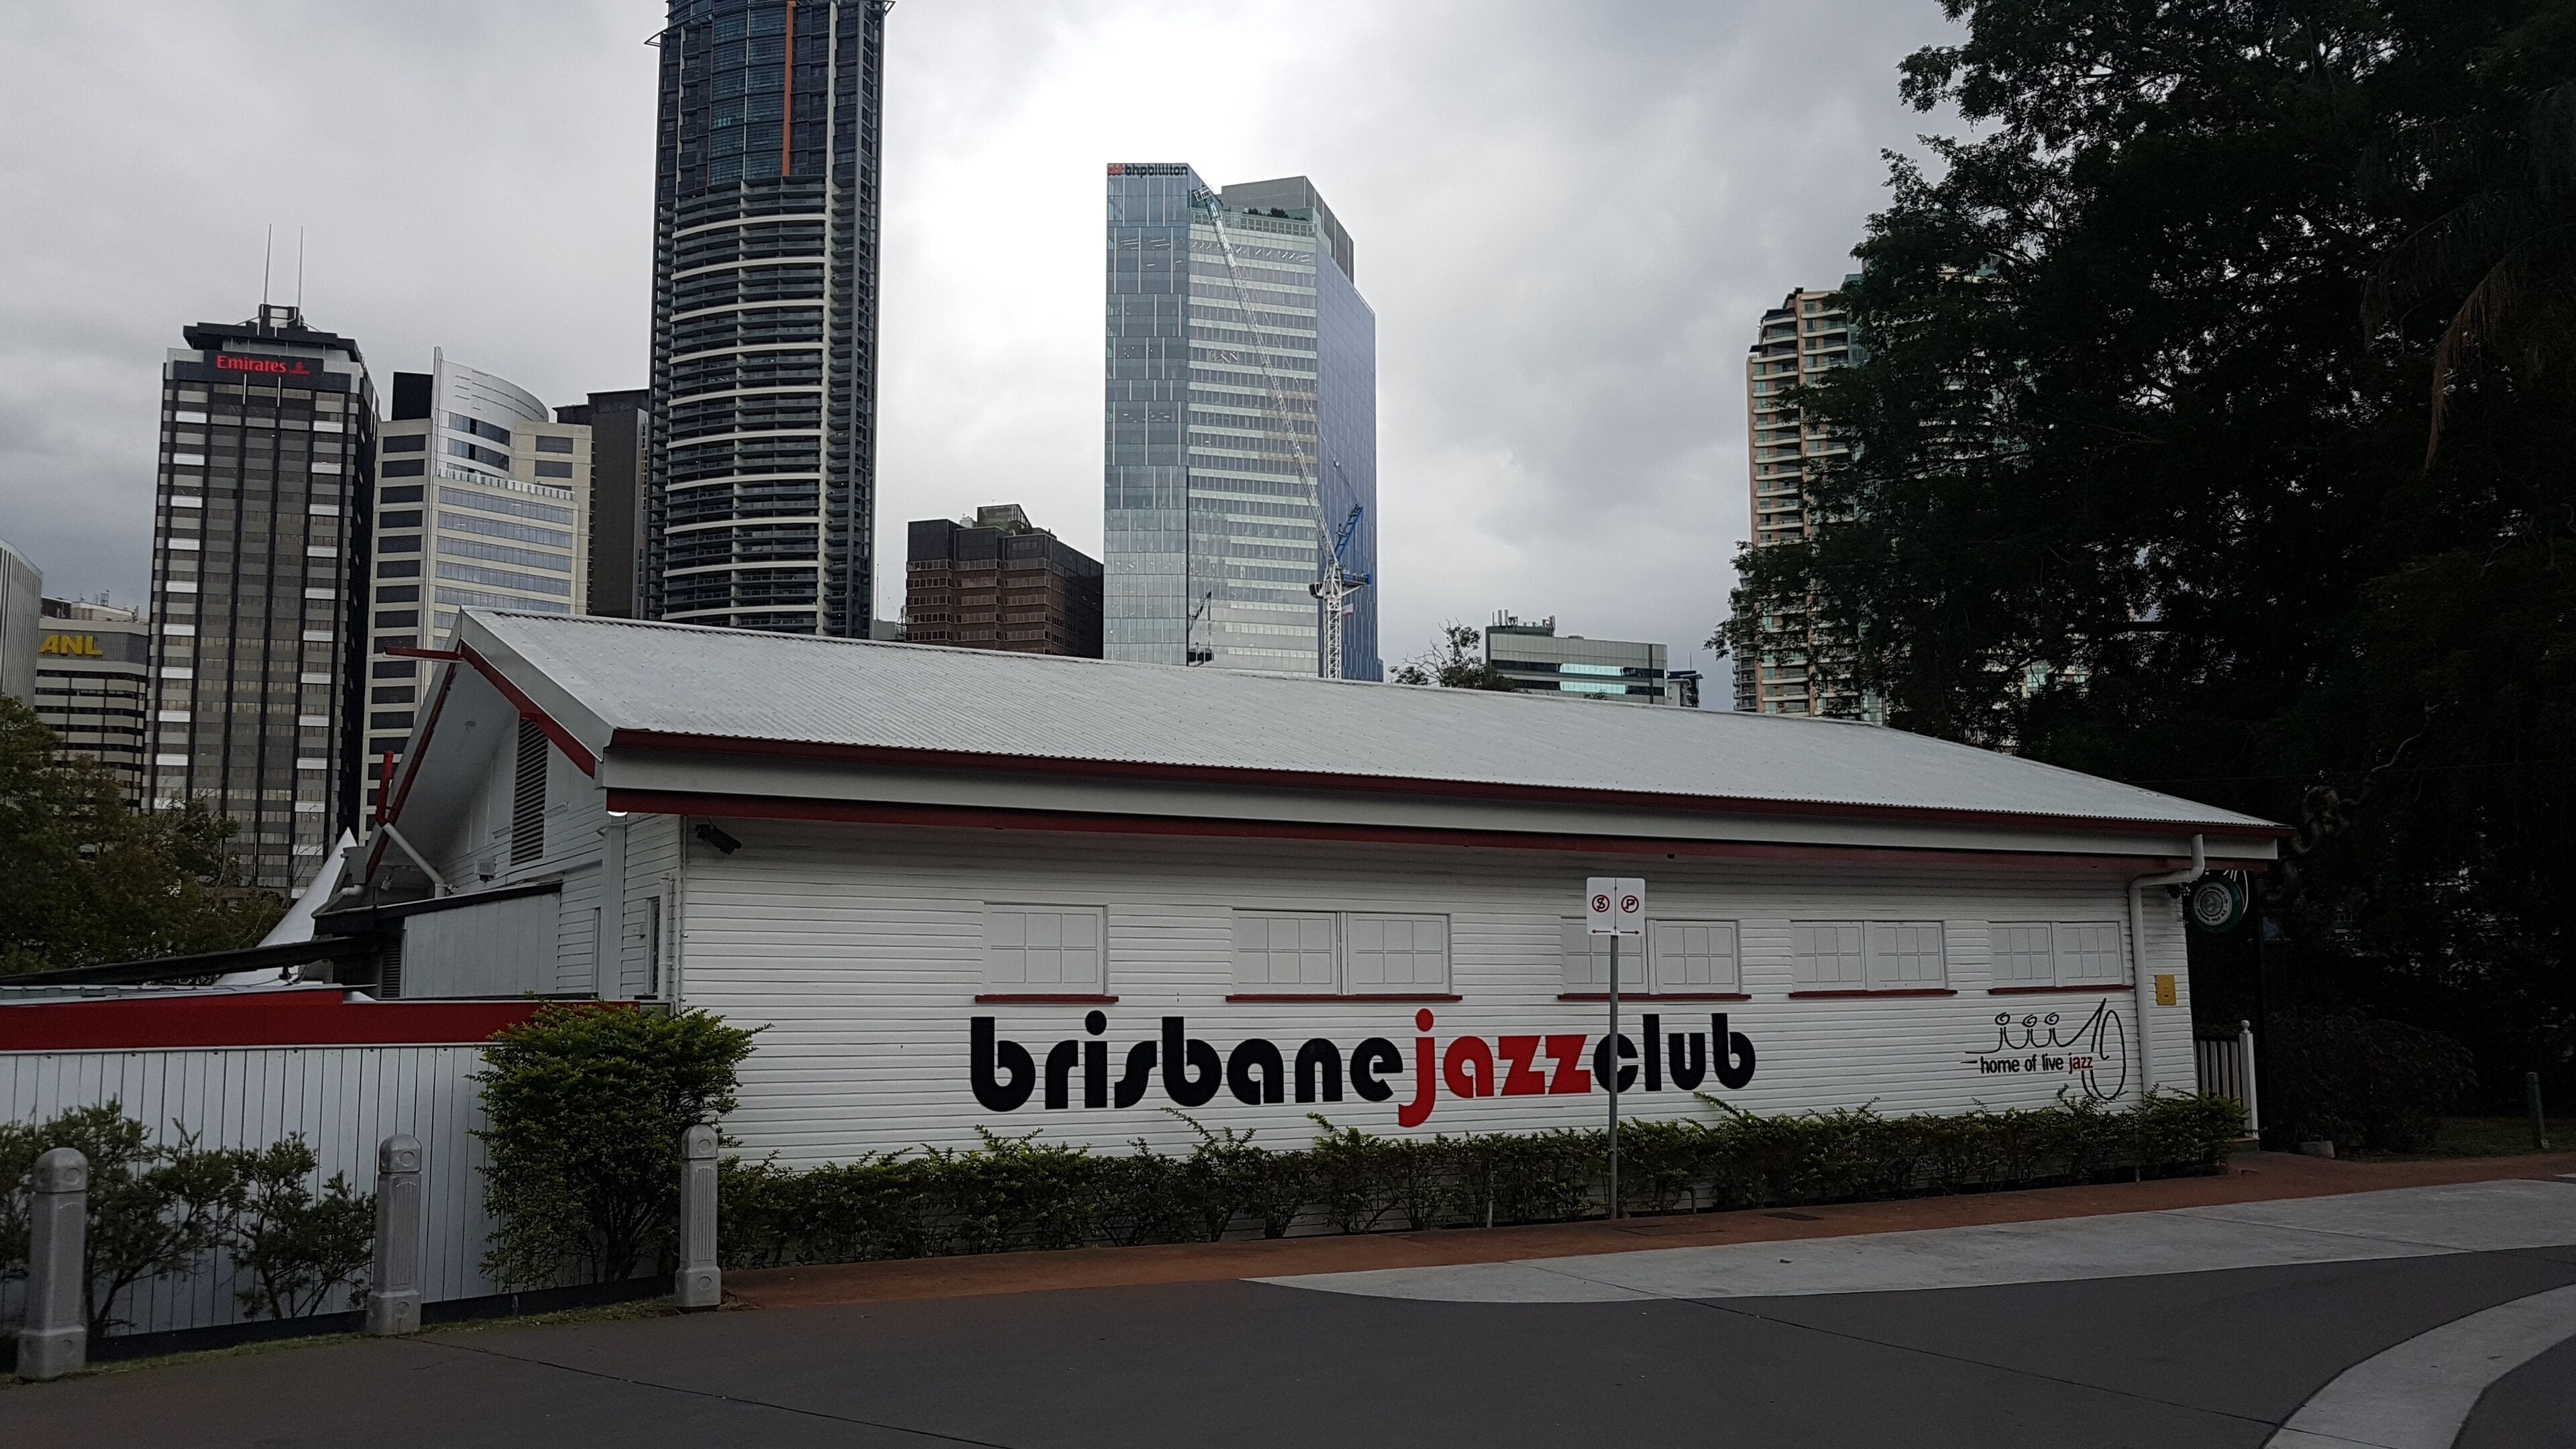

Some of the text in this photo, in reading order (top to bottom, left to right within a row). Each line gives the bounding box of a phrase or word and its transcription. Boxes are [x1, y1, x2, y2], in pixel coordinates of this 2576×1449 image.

[217, 355, 286, 373] Emirates
[38, 635, 103, 655] ANL
[1980, 1052, 2093, 1074] home of live jazz
